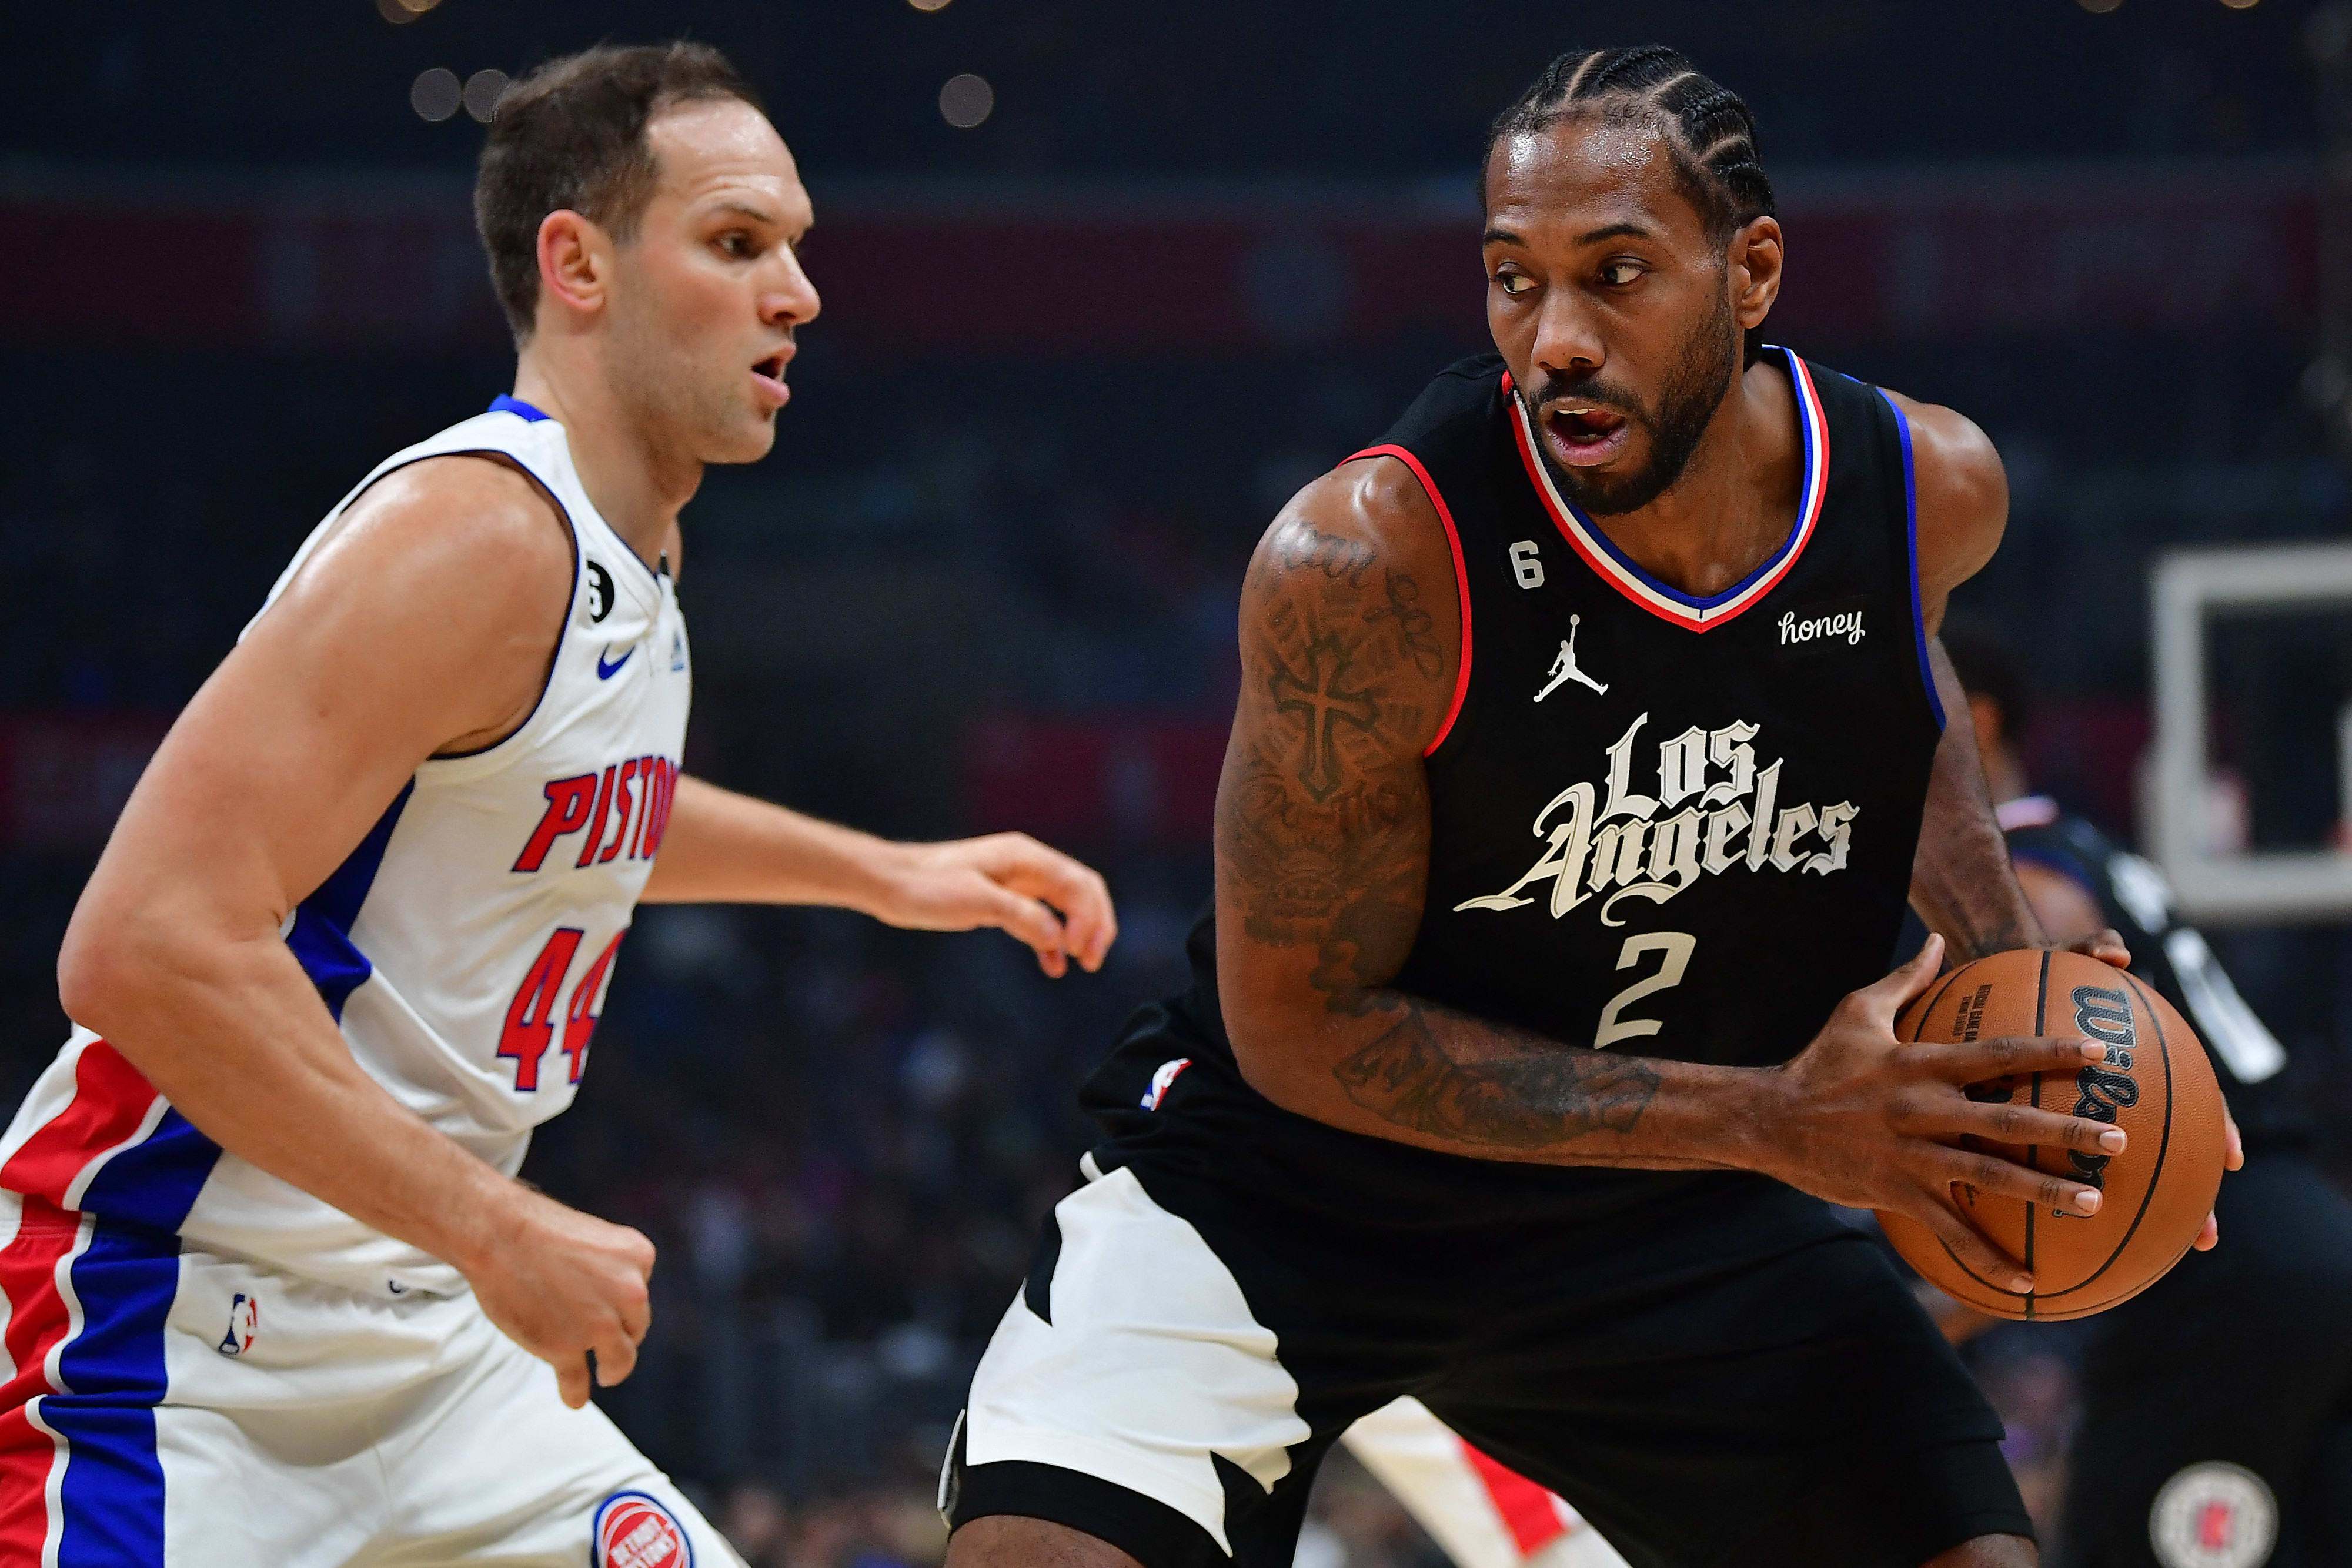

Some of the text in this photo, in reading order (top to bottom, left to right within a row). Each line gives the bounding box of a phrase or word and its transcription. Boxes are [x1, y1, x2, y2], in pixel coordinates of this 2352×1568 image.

[1509, 540, 1545, 589] 6
[1777, 610, 1866, 646] honey
[1593, 711, 1760, 830] Los
[1452, 757, 1860, 927] Angeles
[497, 927, 630, 1091] 44
[1593, 931, 1697, 1049] 2
